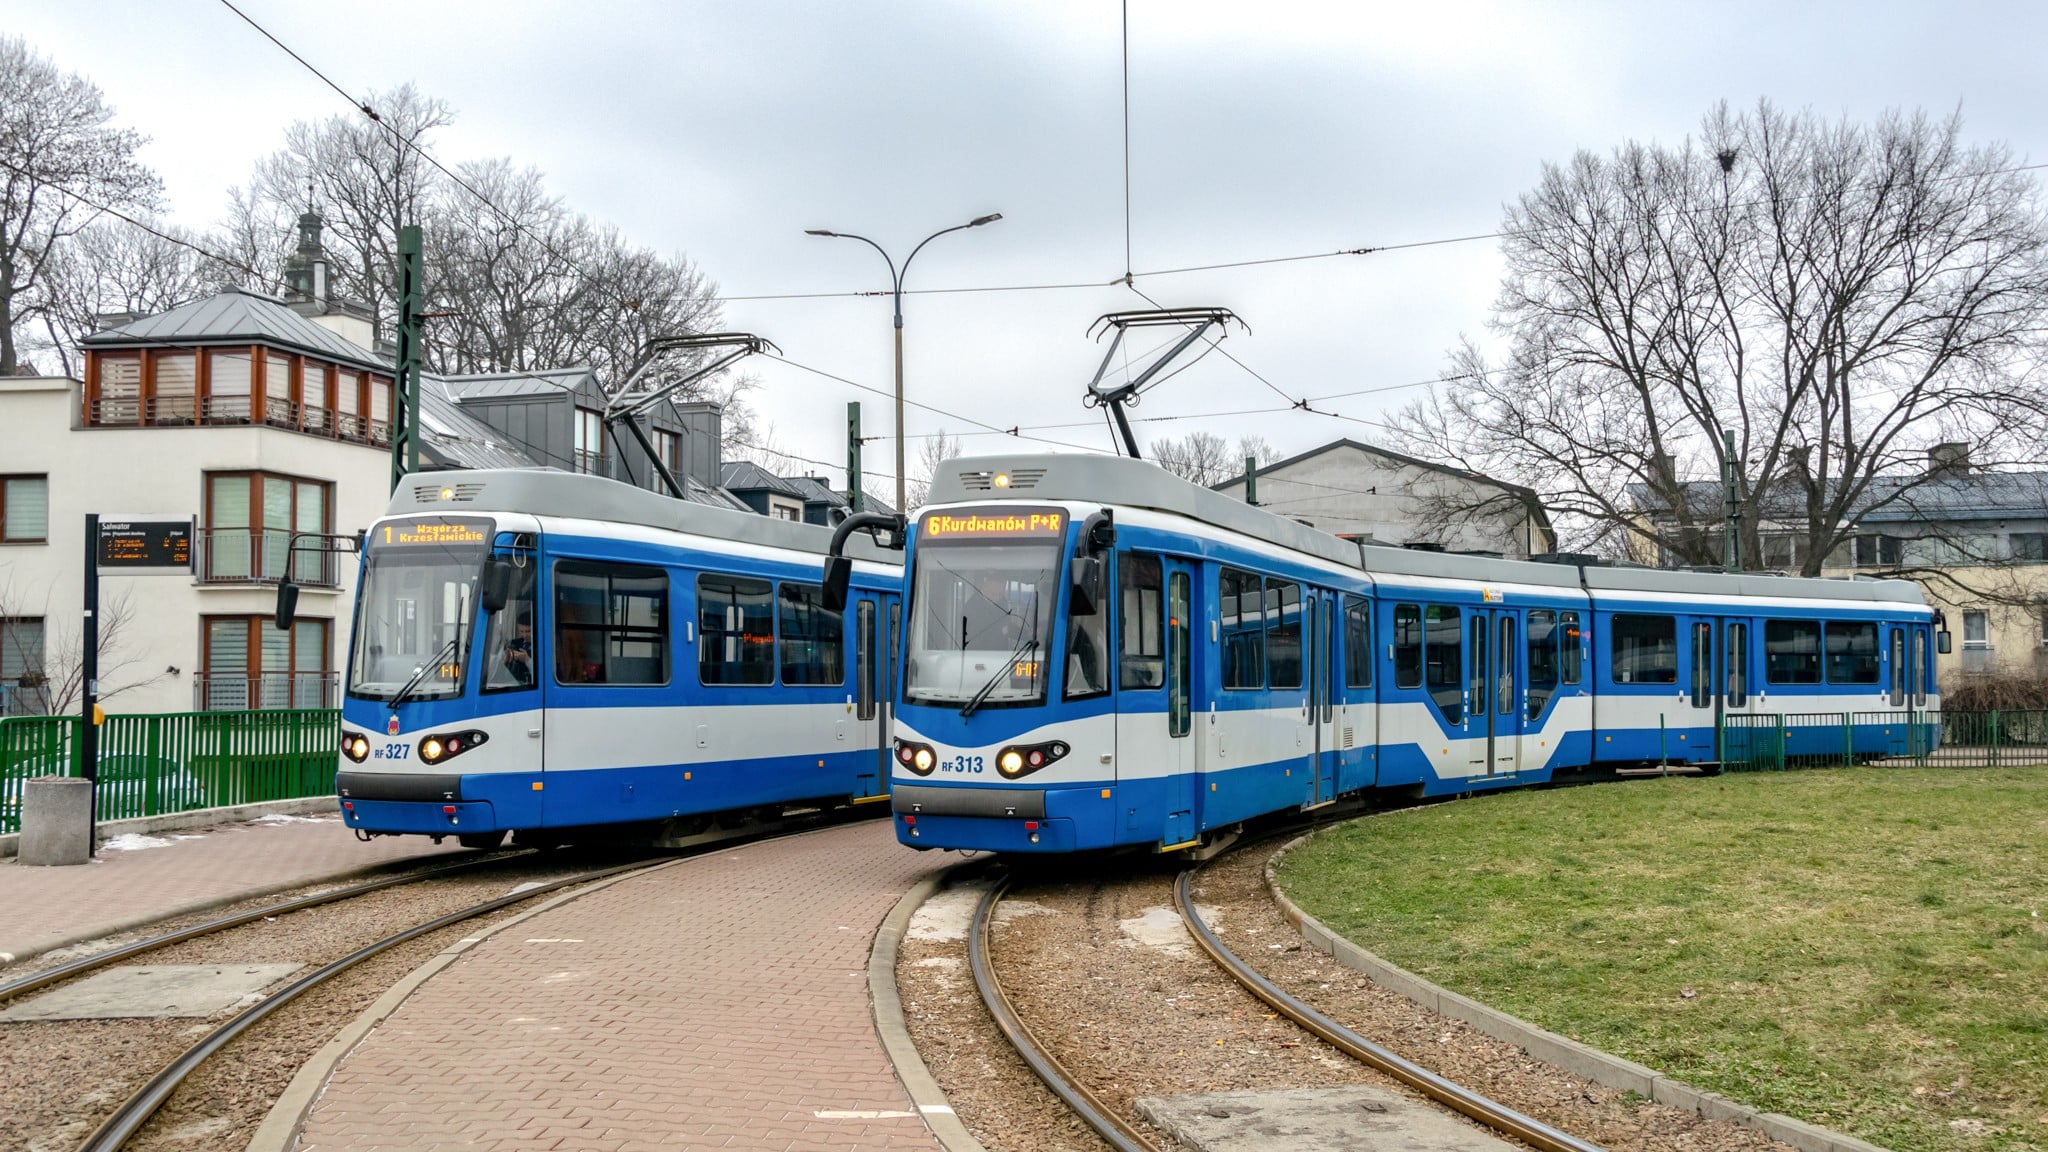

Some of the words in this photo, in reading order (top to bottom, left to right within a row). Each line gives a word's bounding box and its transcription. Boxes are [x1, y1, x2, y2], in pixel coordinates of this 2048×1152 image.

[416, 524, 466, 534] Wzgórza
[928, 516, 941, 536] 6
[941, 516, 1026, 532] Kurdwanów
[1030, 514, 1060, 531] P+R
[384, 526, 393, 544] 1
[374, 749, 384, 759] RF
[385, 743, 410, 759] 327
[942, 762, 953, 772] RF
[955, 755, 983, 773] 313
